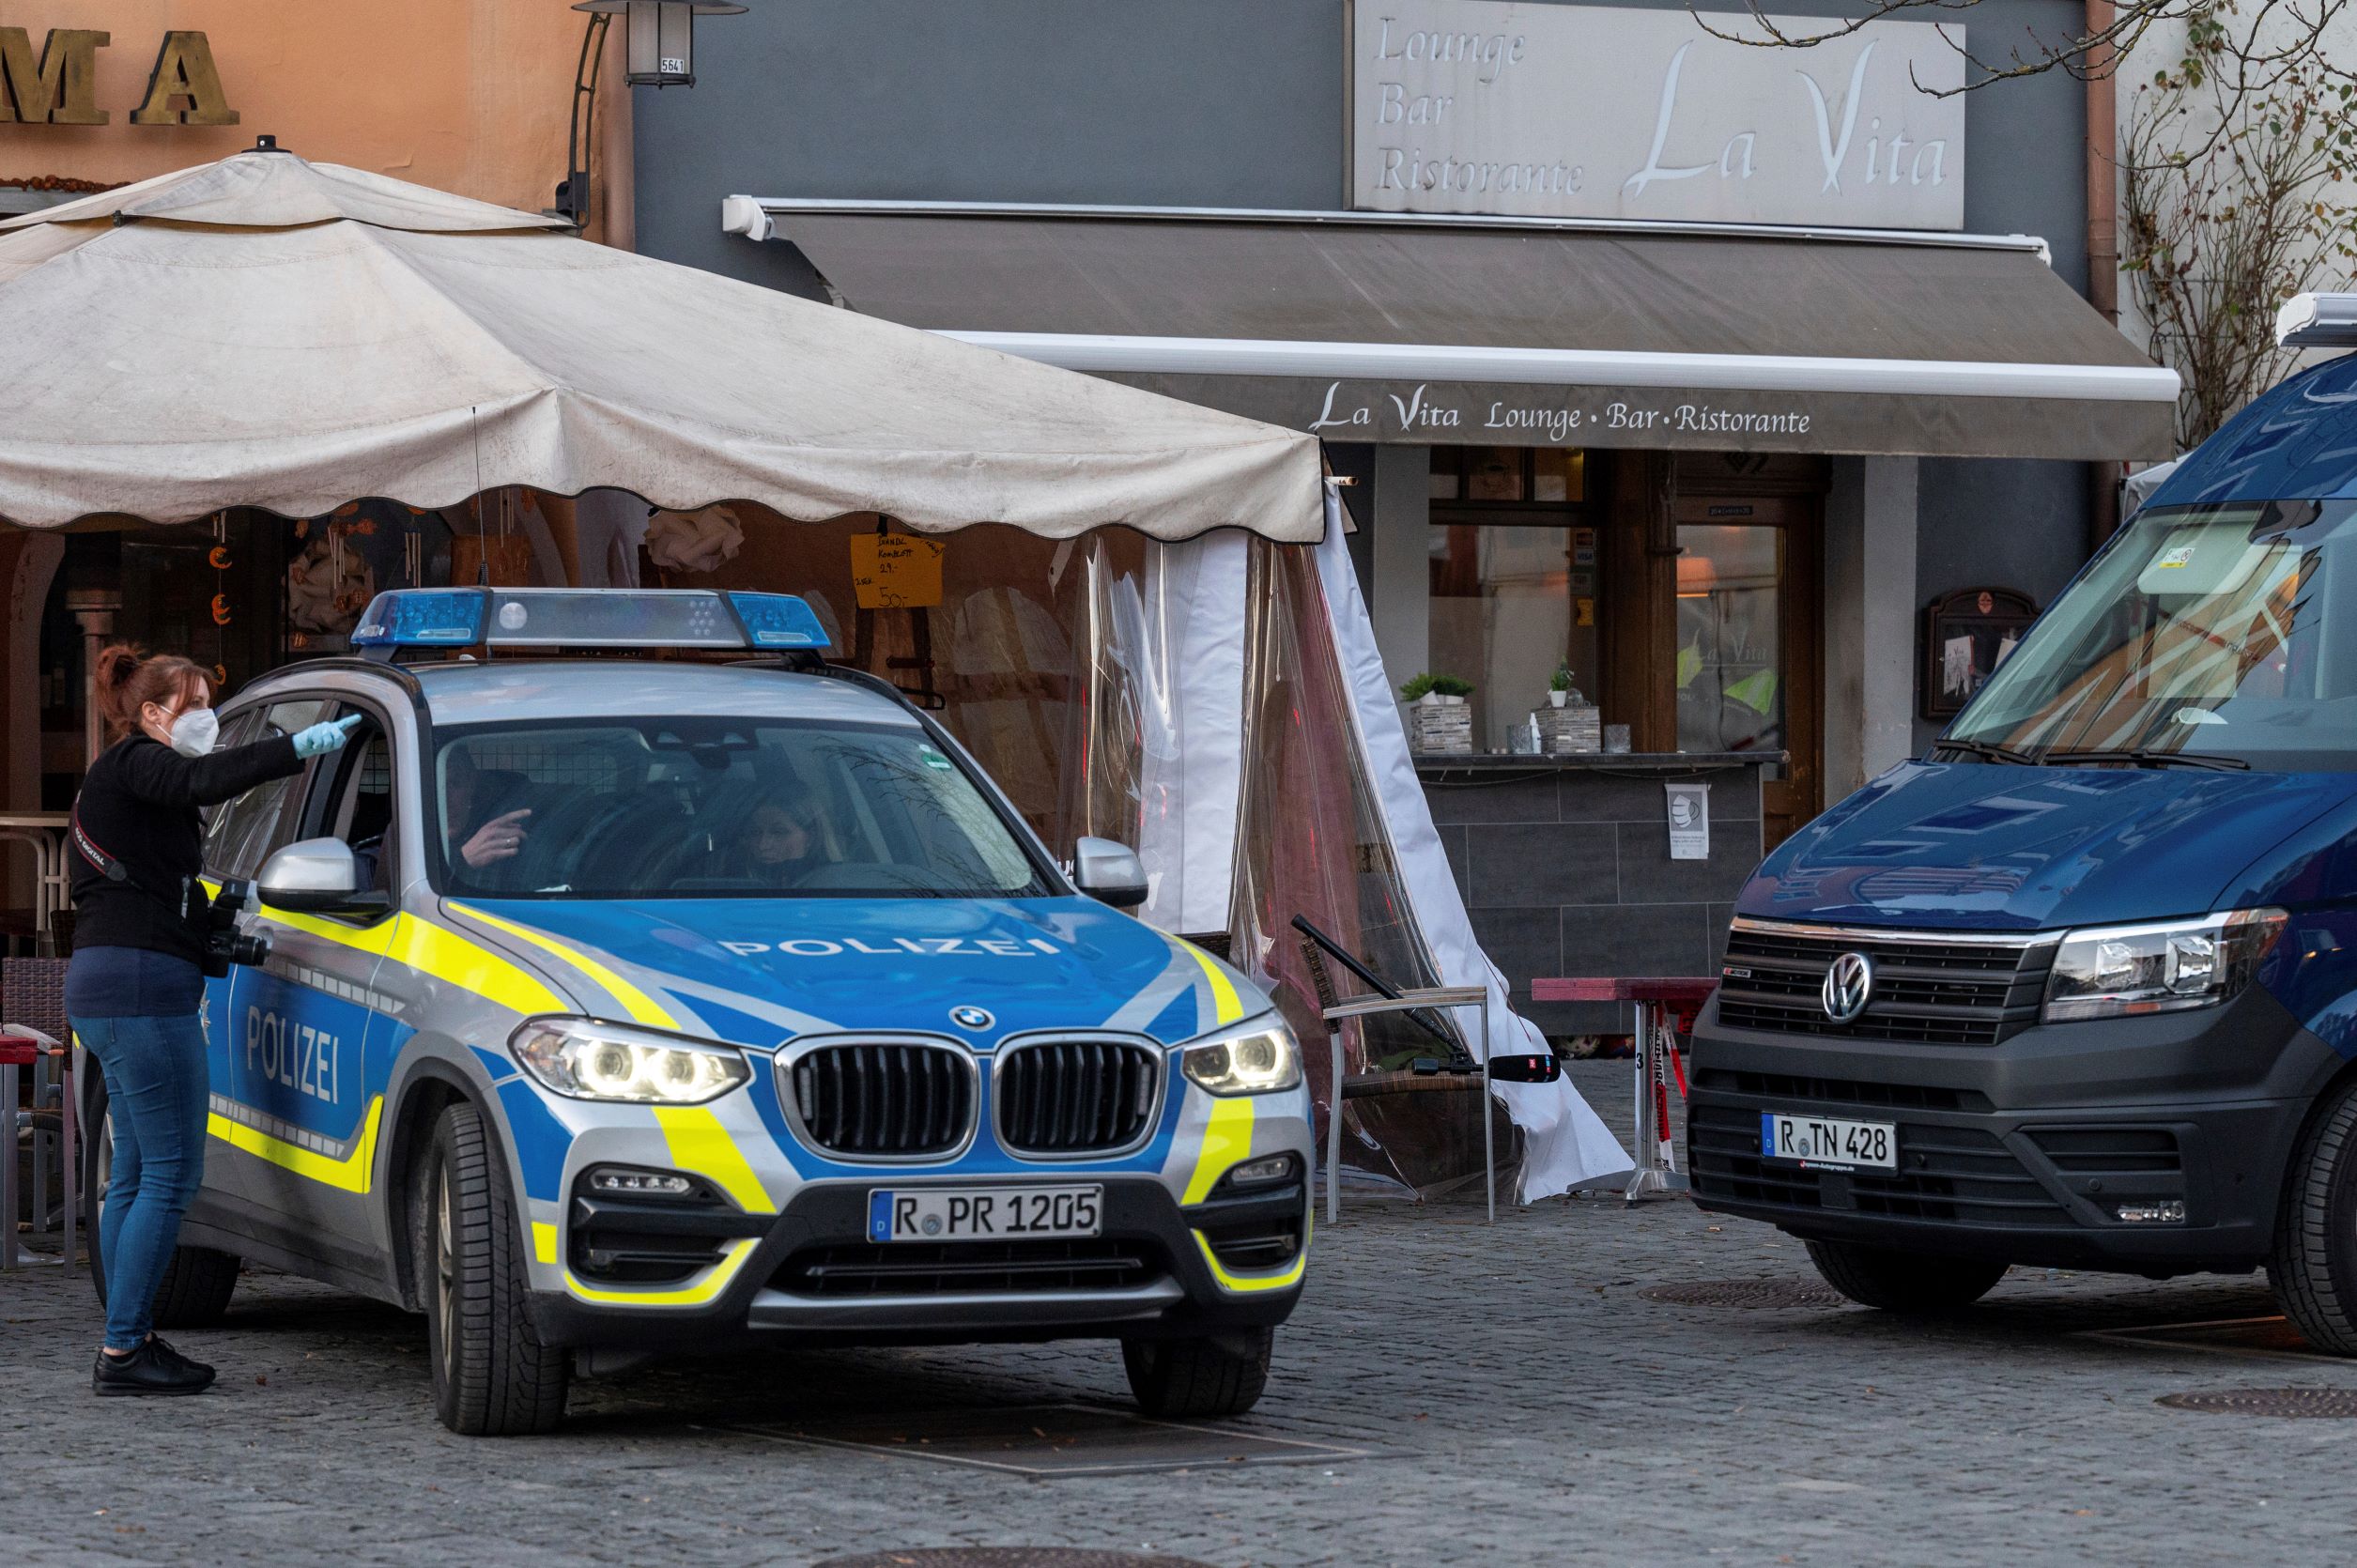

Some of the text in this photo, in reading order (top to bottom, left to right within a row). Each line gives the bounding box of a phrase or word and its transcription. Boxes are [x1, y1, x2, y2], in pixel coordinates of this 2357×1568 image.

[662, 59, 684, 71] 5641
[1375, 16, 1525, 84] Lounge
[1375, 81, 1454, 127] Bar
[1620, 38, 1949, 199] La Vita
[1375, 146, 1584, 196] Ristorante
[1308, 381, 1811, 442] La Vita Lounge Bar Ristorante
[717, 938, 1061, 957] POLIZEI
[248, 1006, 338, 1104] POLIZEI
[1781, 1120, 1795, 1153] R
[1810, 1123, 1838, 1157] TN
[1846, 1127, 1887, 1161] 428
[895, 1198, 917, 1234] R
[948, 1196, 994, 1234] PR
[1006, 1193, 1097, 1232] 1205
